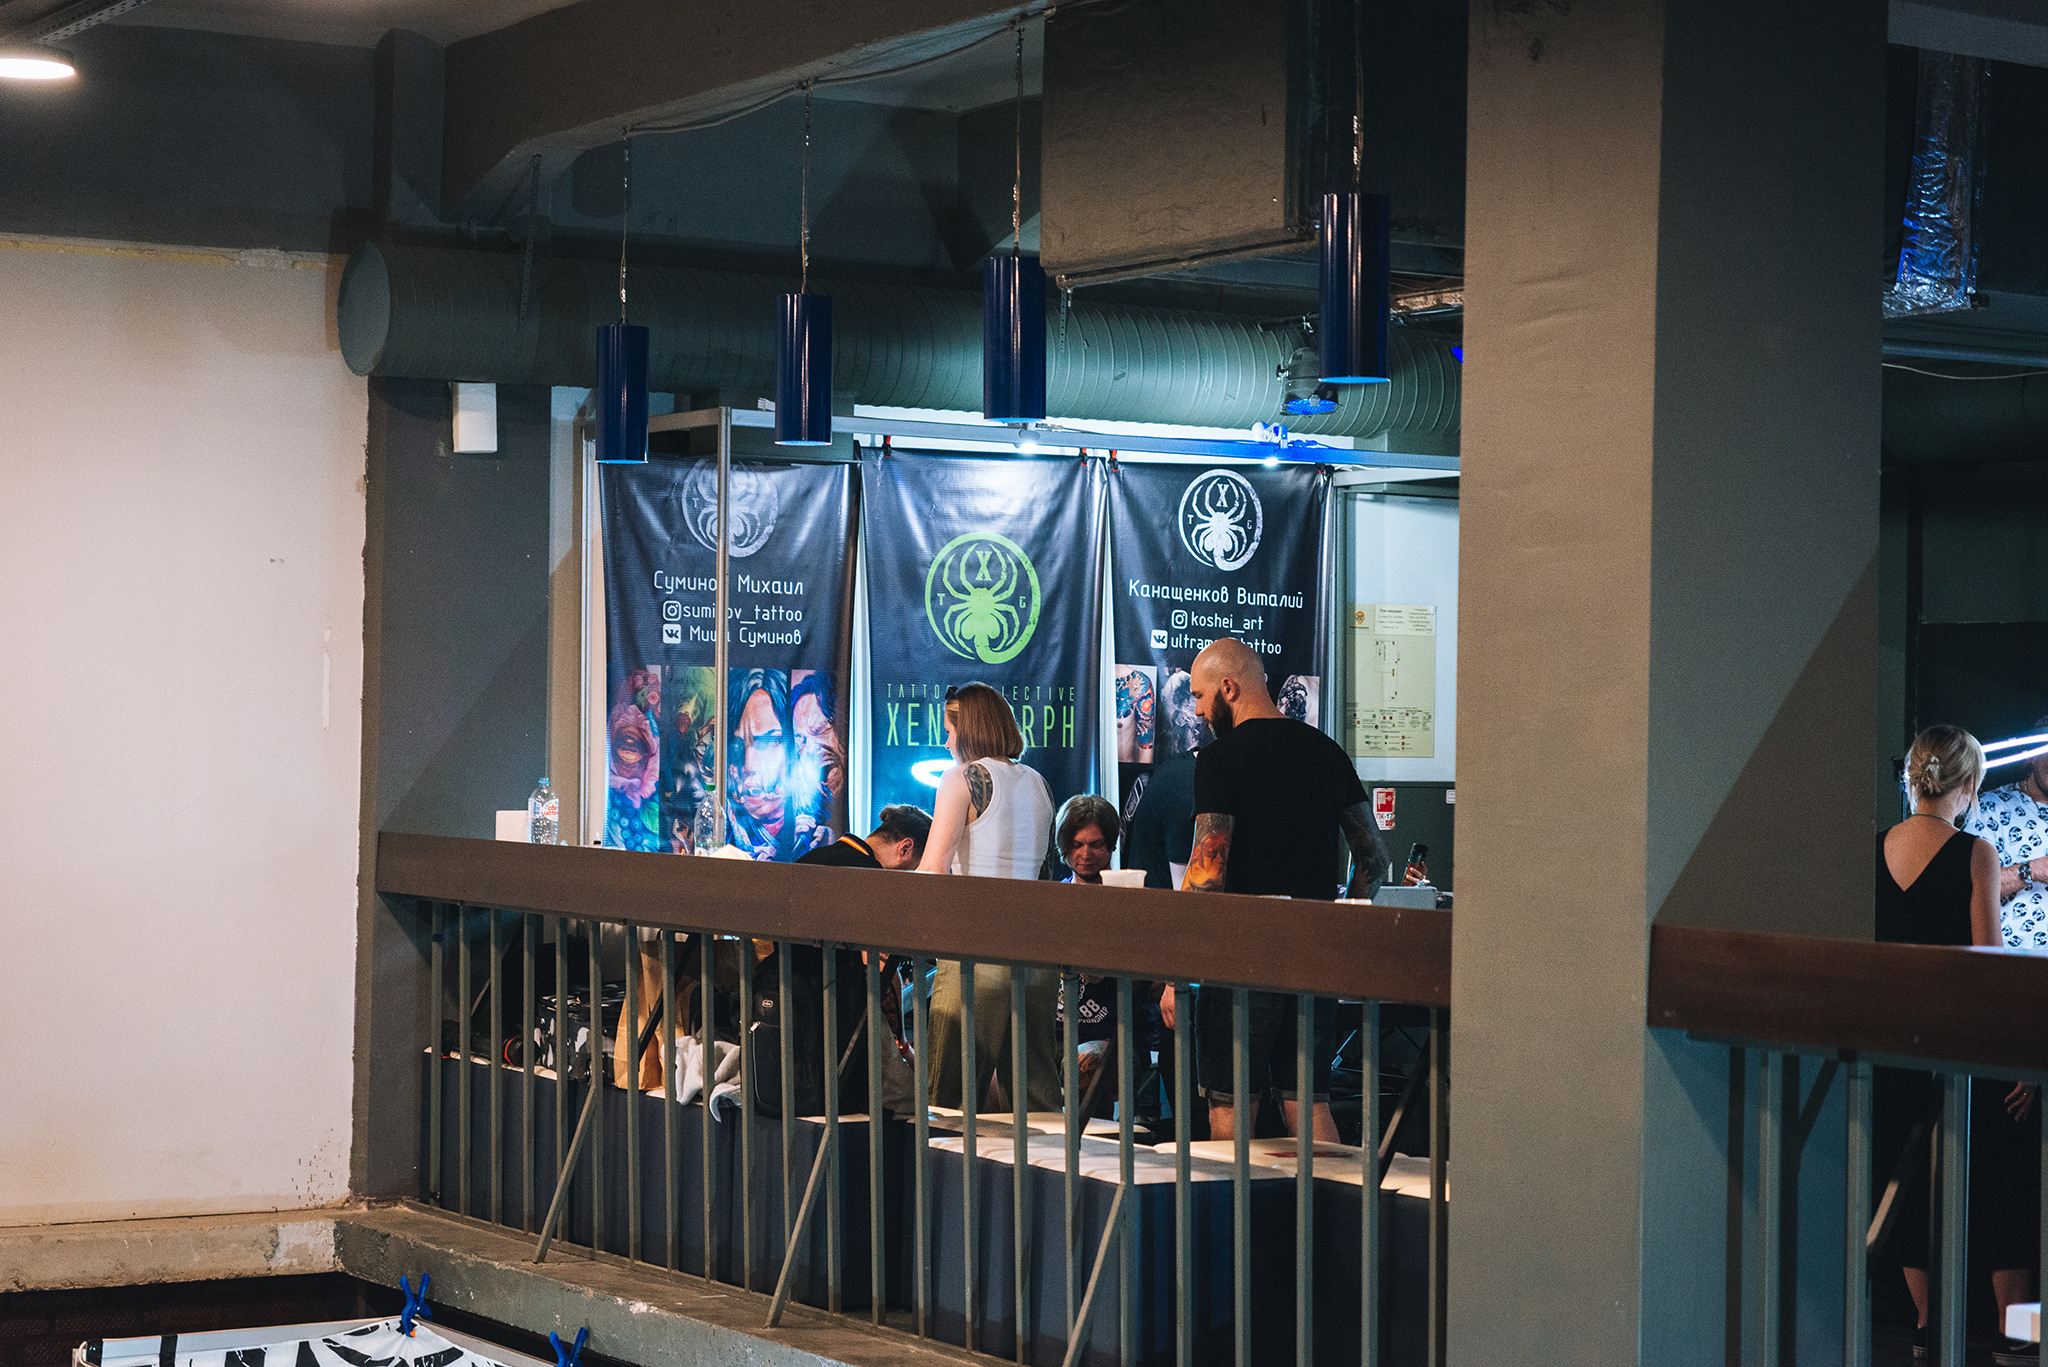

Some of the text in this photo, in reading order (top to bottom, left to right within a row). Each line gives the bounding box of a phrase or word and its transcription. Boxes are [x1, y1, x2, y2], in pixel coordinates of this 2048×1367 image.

[975, 551, 992, 581] X
[654, 570, 804, 596] Сумино Михаил
[1128, 579, 1304, 609] Канащенков Виталий
[683, 602, 803, 625] sumiov_tattoo
[1191, 611, 1264, 633] koshei_art
[739, 626, 802, 648] Суминов
[887, 683, 1075, 702] TATTO LECTIVE
[886, 703, 1075, 748] XENRPH
[1079, 998, 1101, 1018] 88
